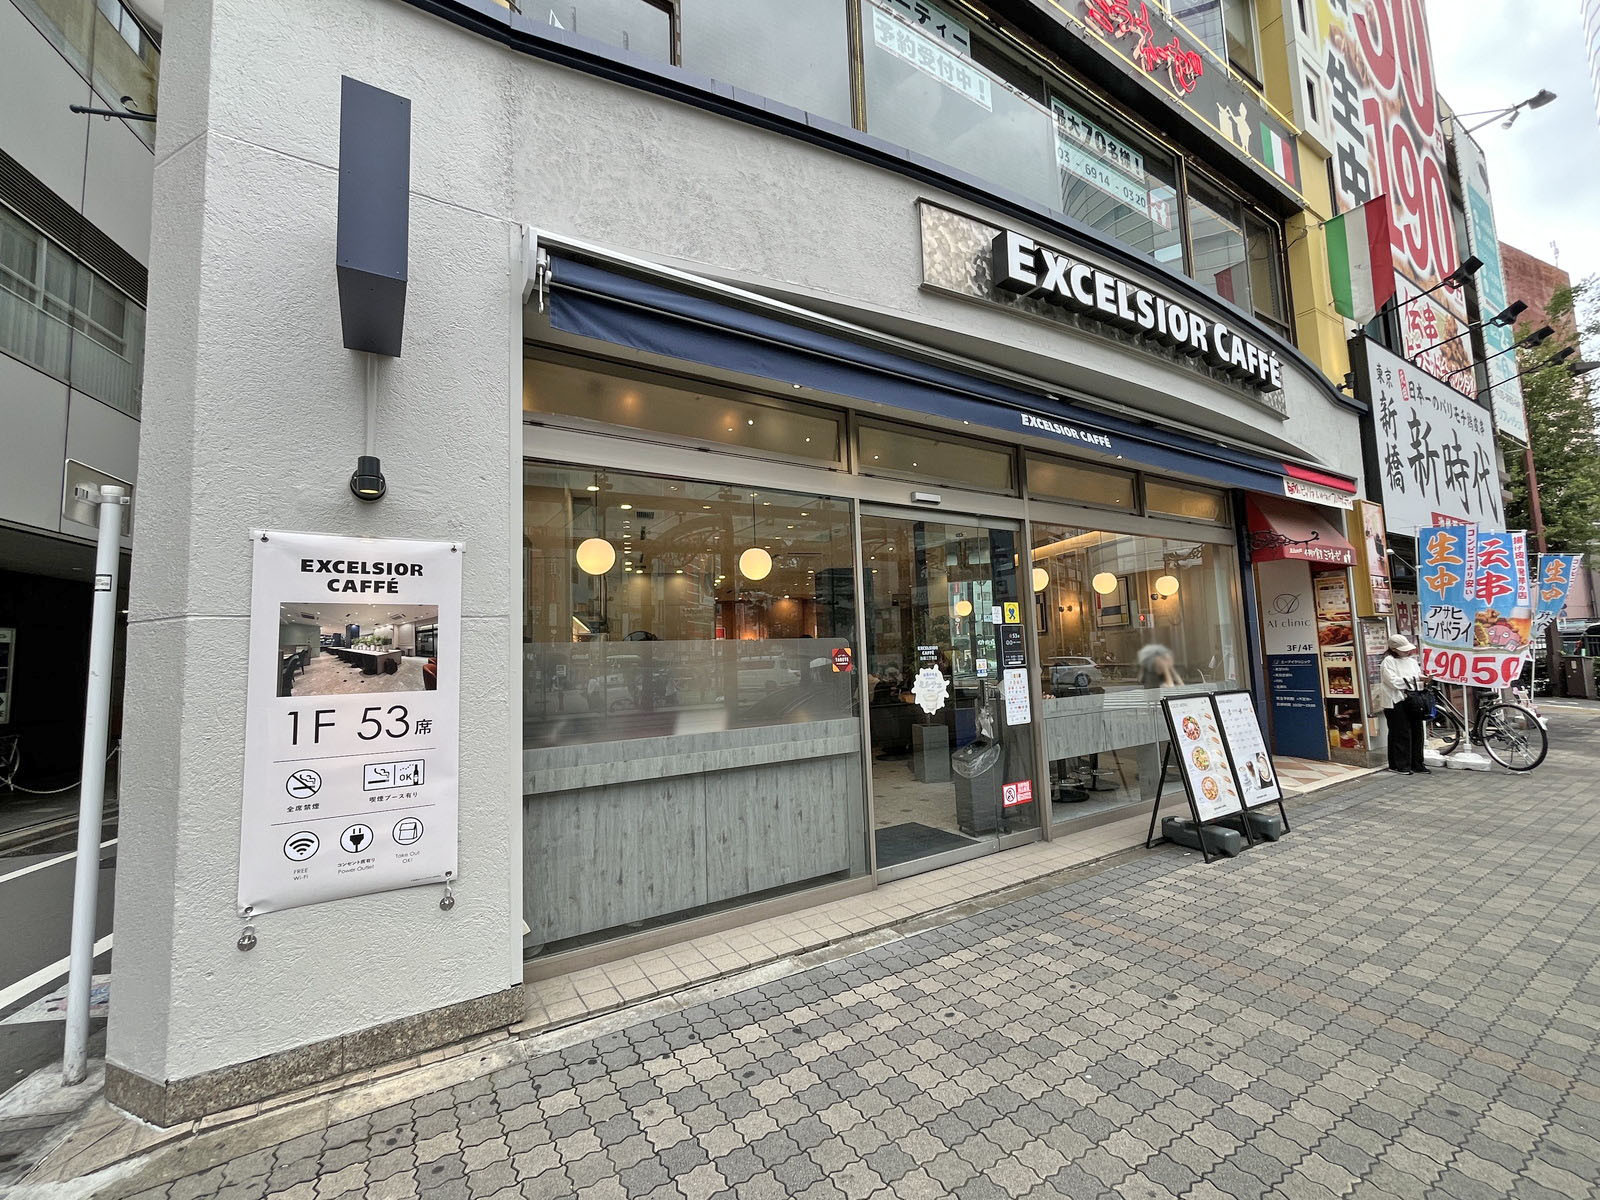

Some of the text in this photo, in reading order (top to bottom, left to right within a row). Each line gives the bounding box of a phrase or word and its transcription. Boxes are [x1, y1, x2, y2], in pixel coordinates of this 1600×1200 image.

[885, 0, 967, 46] ーティー
[1362, 97, 1455, 294] 190
[1004, 229, 1282, 391] EXCELSIOR CAFFÉ
[1020, 413, 1112, 448] EXCELSIOR CAFFÉ
[1406, 406, 1499, 523] 新時代
[300, 558, 424, 577] EXCELSIOR
[1424, 532, 1462, 600] 生中
[327, 578, 399, 594] CAFFÉ
[1429, 605, 1463, 620] アサヒ
[1281, 618, 1311, 628] clinic
[287, 705, 433, 745] 1F 53席
[399, 773, 413, 783] OK
[369, 791, 418, 804] 喫煙ブース有り
[286, 802, 320, 813] 全席禁煙
[338, 867, 356, 875] Power
